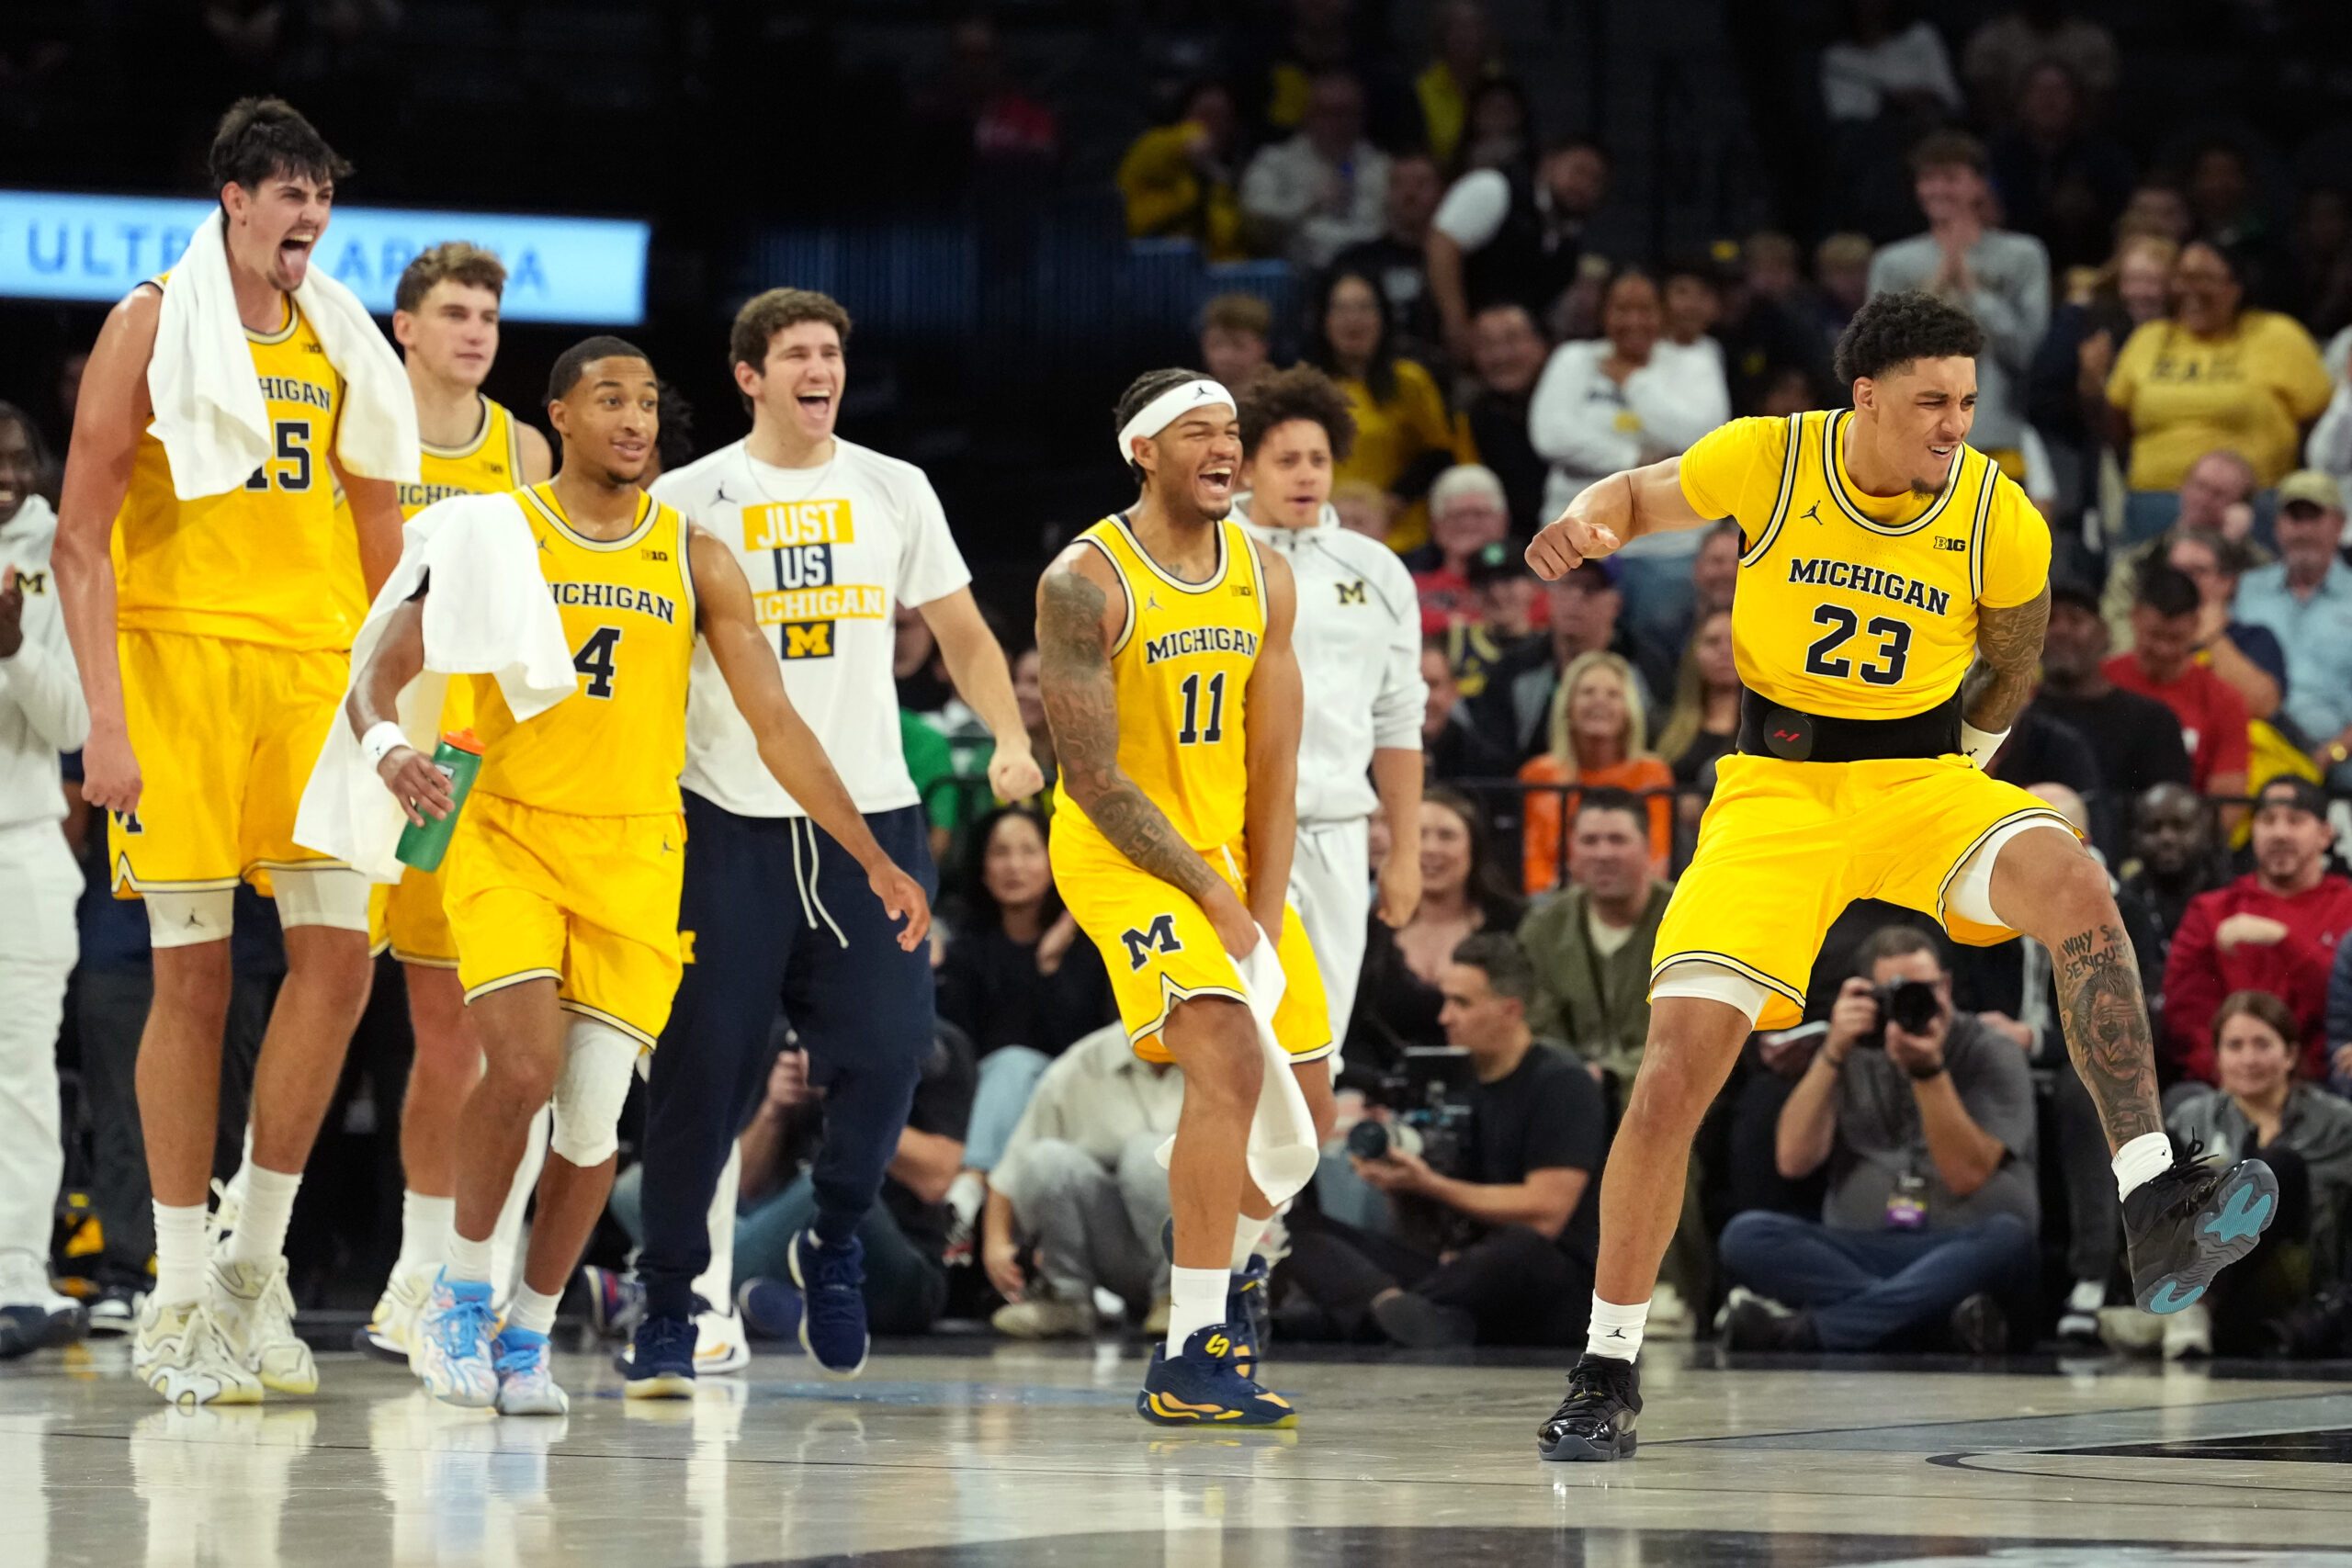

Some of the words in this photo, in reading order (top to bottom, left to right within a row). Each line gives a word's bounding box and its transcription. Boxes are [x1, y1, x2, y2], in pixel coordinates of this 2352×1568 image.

[258, 377, 331, 412] HIGAN
[756, 502, 839, 547] JUST
[14, 571, 46, 594] M
[780, 544, 827, 590] US
[1788, 558, 1951, 616] MICHIGAN
[548, 582, 675, 625] ICHIGAN
[755, 587, 884, 622] ICHIGAN
[1334, 580, 1366, 604] M
[786, 623, 831, 658] M
[1146, 627, 1258, 665] MICHIGAN
[1804, 603, 1914, 686] 23
[572, 626, 622, 699] 4
[1179, 671, 1226, 745] 11
[1120, 913, 1182, 972] M
[2061, 928, 2094, 957] WHY
